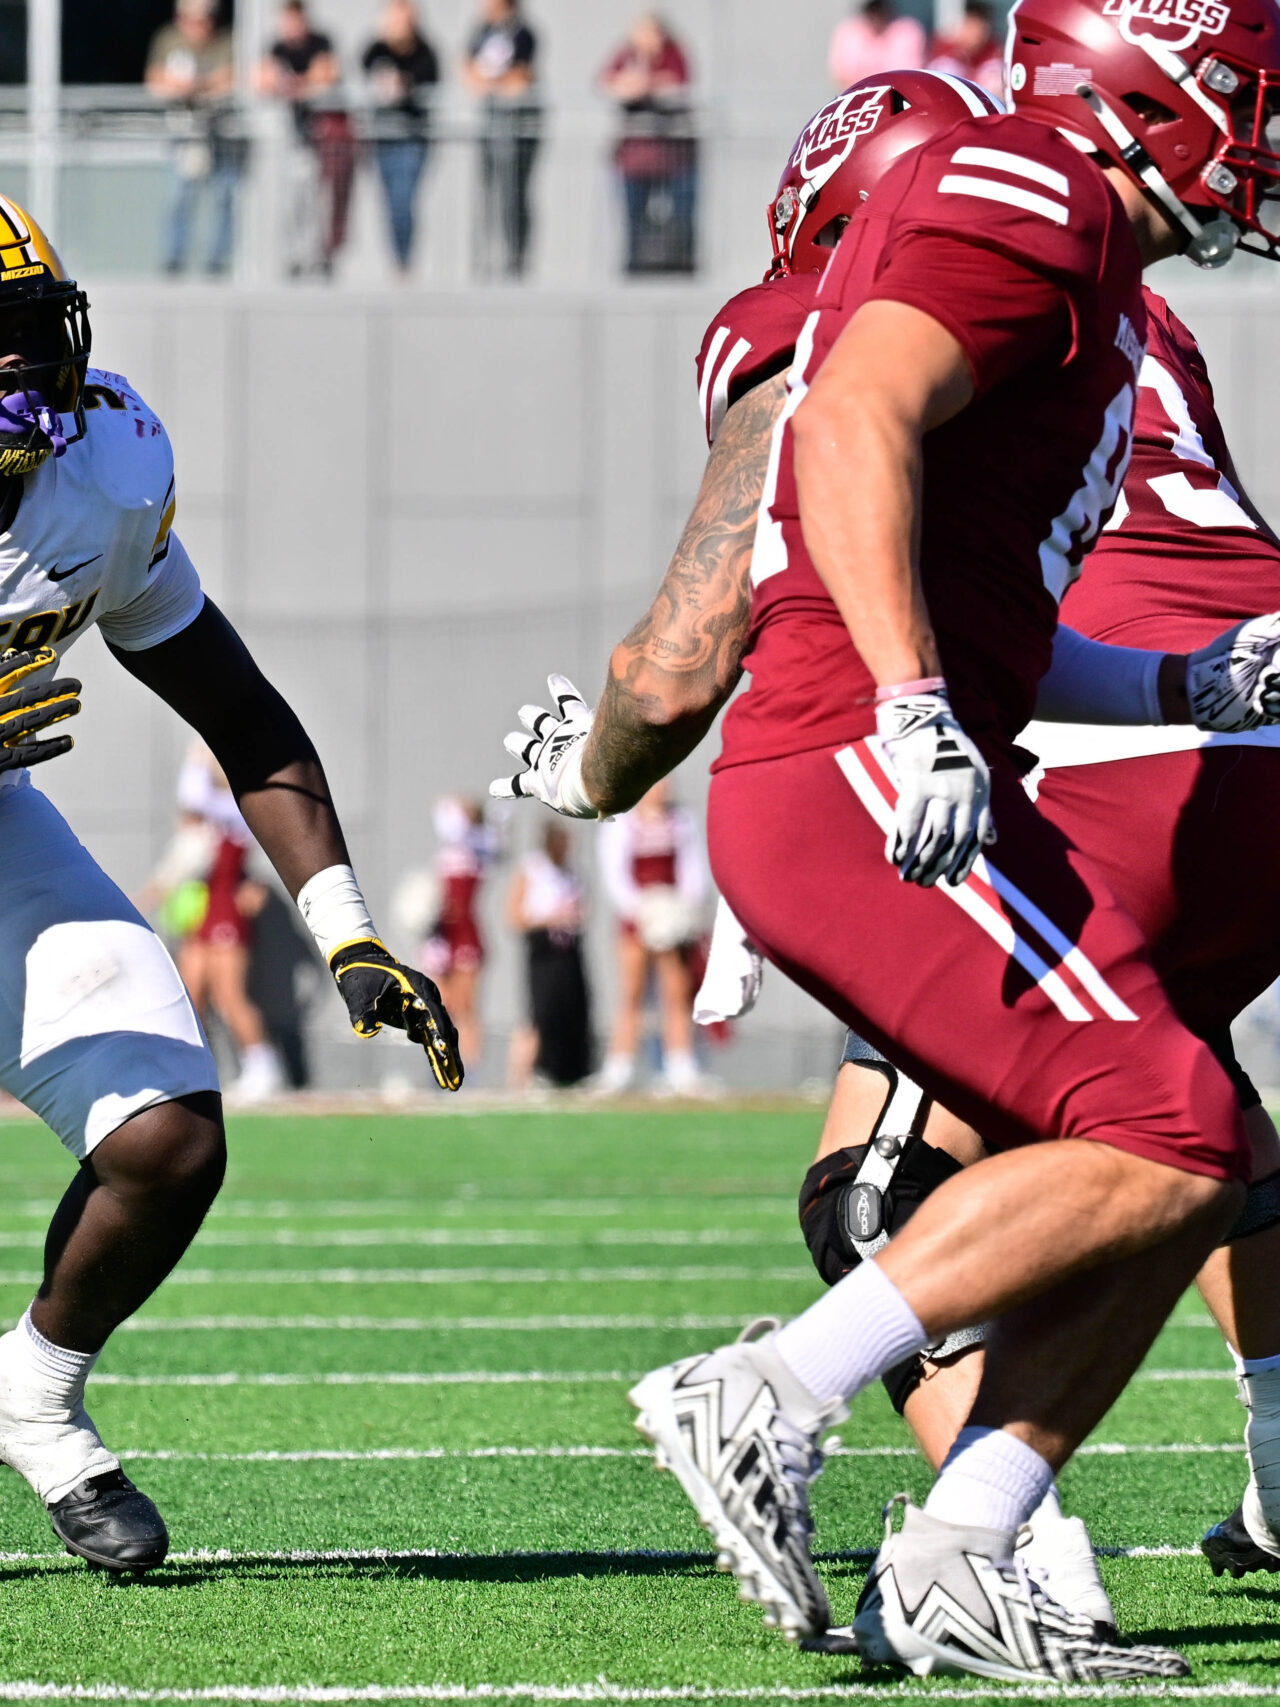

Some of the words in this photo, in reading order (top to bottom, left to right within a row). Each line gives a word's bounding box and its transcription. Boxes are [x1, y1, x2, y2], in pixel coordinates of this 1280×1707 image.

[792, 104, 884, 168] MASS
[1, 264, 45, 282] MIZZOU
[1102, 353, 1261, 531] 3
